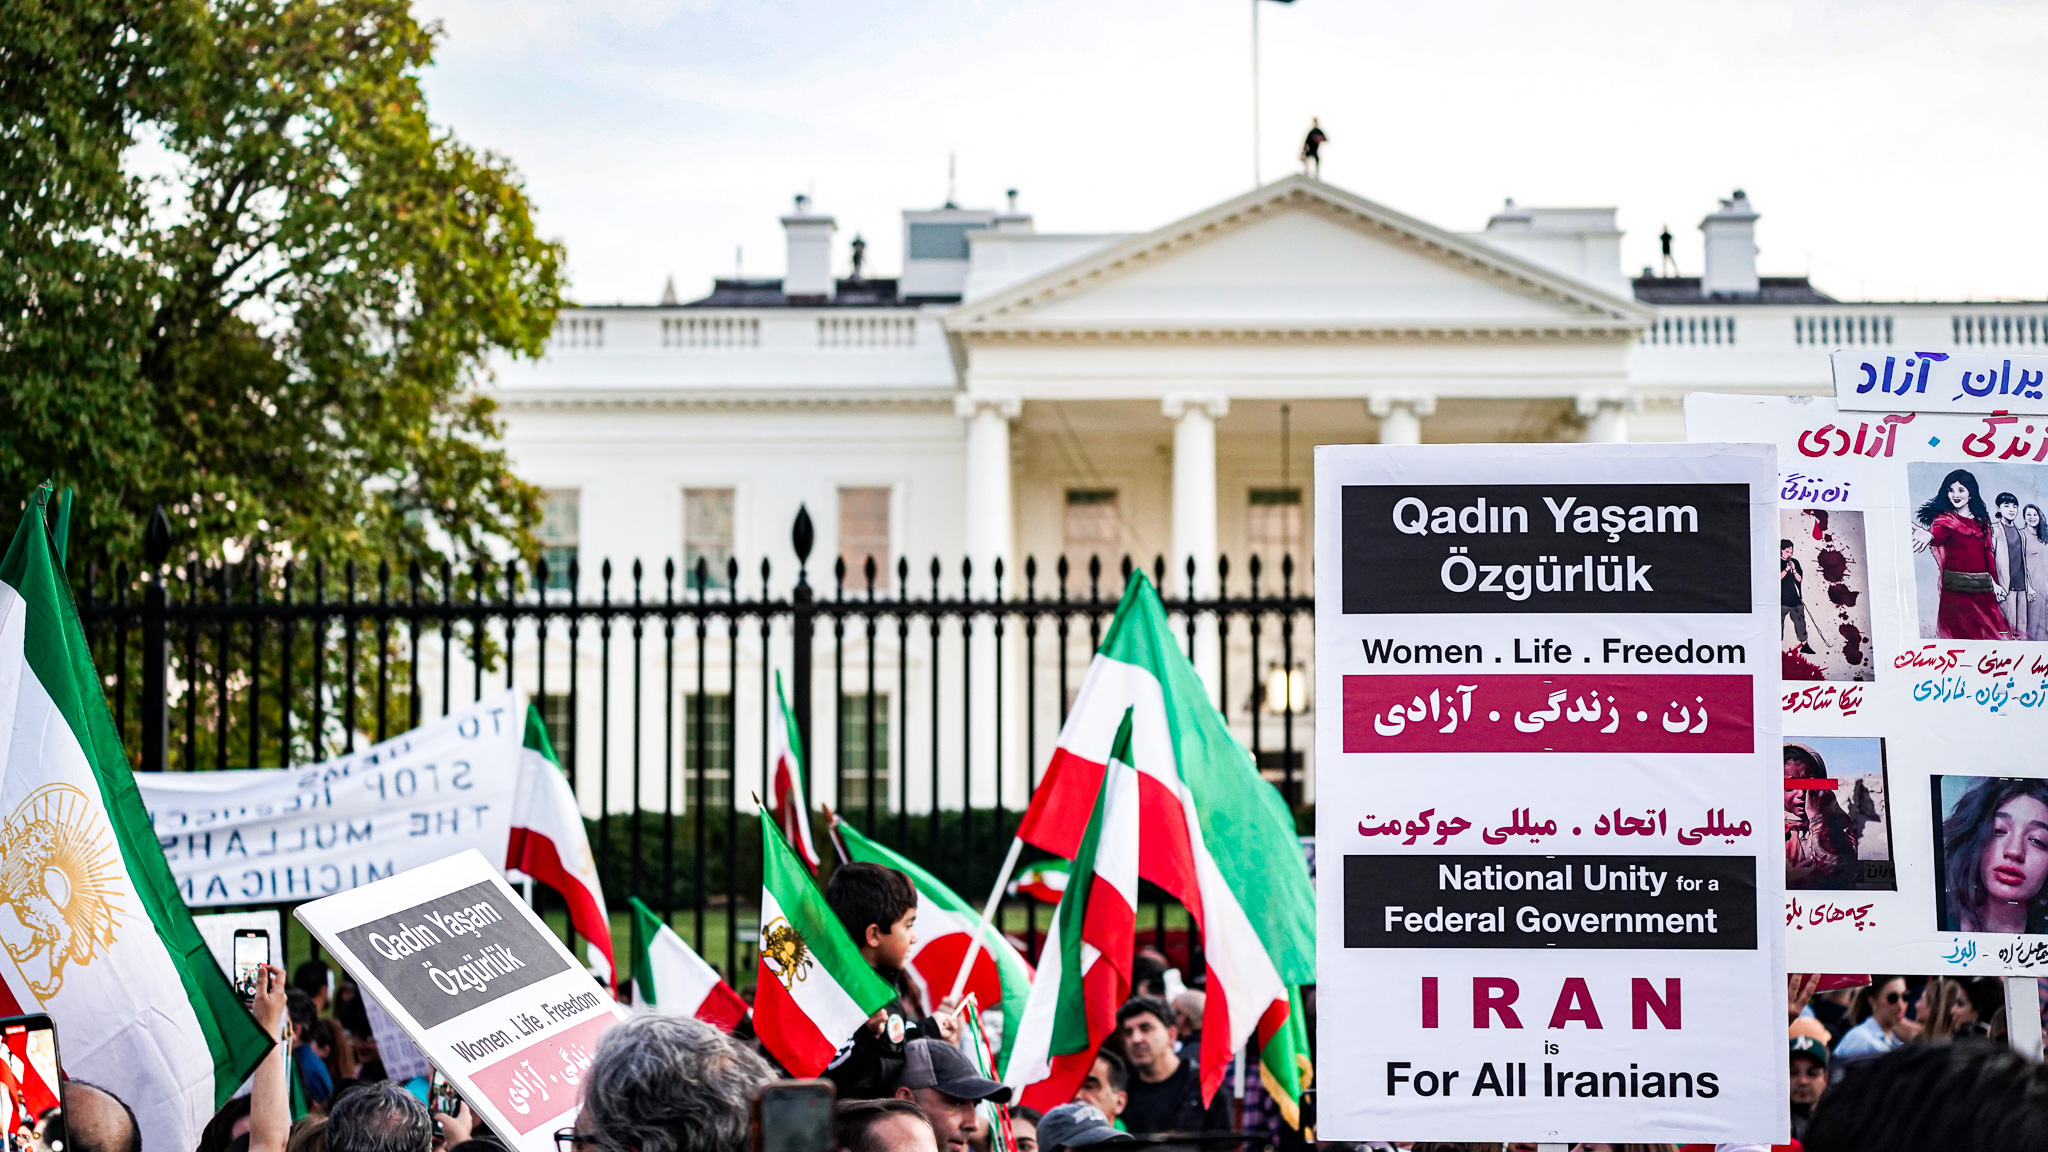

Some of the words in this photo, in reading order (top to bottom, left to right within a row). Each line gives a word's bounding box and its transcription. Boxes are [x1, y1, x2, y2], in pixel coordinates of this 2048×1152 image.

[1856, 351, 1949, 396] آزاد
[1798, 412, 1916, 457] آزادی
[1781, 473, 1823, 503] زندگی
[1393, 497, 1528, 536] Qadın
[1543, 497, 1698, 542] Yaşam
[1441, 547, 1653, 600] Özgürlük
[1362, 639, 1482, 663] Women
[1515, 639, 1571, 663] Life
[1603, 639, 1745, 663] Freedom
[1894, 644, 1966, 675] کردستان
[1374, 685, 1477, 736] آزادی
[1514, 689, 1619, 733] زندگی
[1663, 696, 1707, 733] زن
[1358, 808, 1471, 845] حوکومت
[1483, 808, 1557, 845] میللی
[1595, 808, 1666, 836] اتحاد
[1678, 808, 1752, 845] میللی
[1440, 865, 1572, 890] National
[1585, 865, 1667, 896] Unity
[1676, 876, 1703, 890] for
[1708, 880, 1718, 891] a
[368, 922, 441, 960] Qadın
[424, 900, 502, 939] Yaşam
[1385, 906, 1504, 932] Federal
[1516, 906, 1717, 933] Government
[421, 943, 526, 996] Özgürlük
[1422, 977, 1681, 1029] IRAN
[450, 1027, 512, 1063] Women
[510, 1012, 544, 1036] Life
[541, 989, 600, 1024] Freedom
[1545, 1040, 1559, 1054] is
[507, 1058, 550, 1114] آزادی
[1387, 1062, 1459, 1096] For
[1472, 1063, 1526, 1096] All
[1544, 1063, 1719, 1098] Iranians
